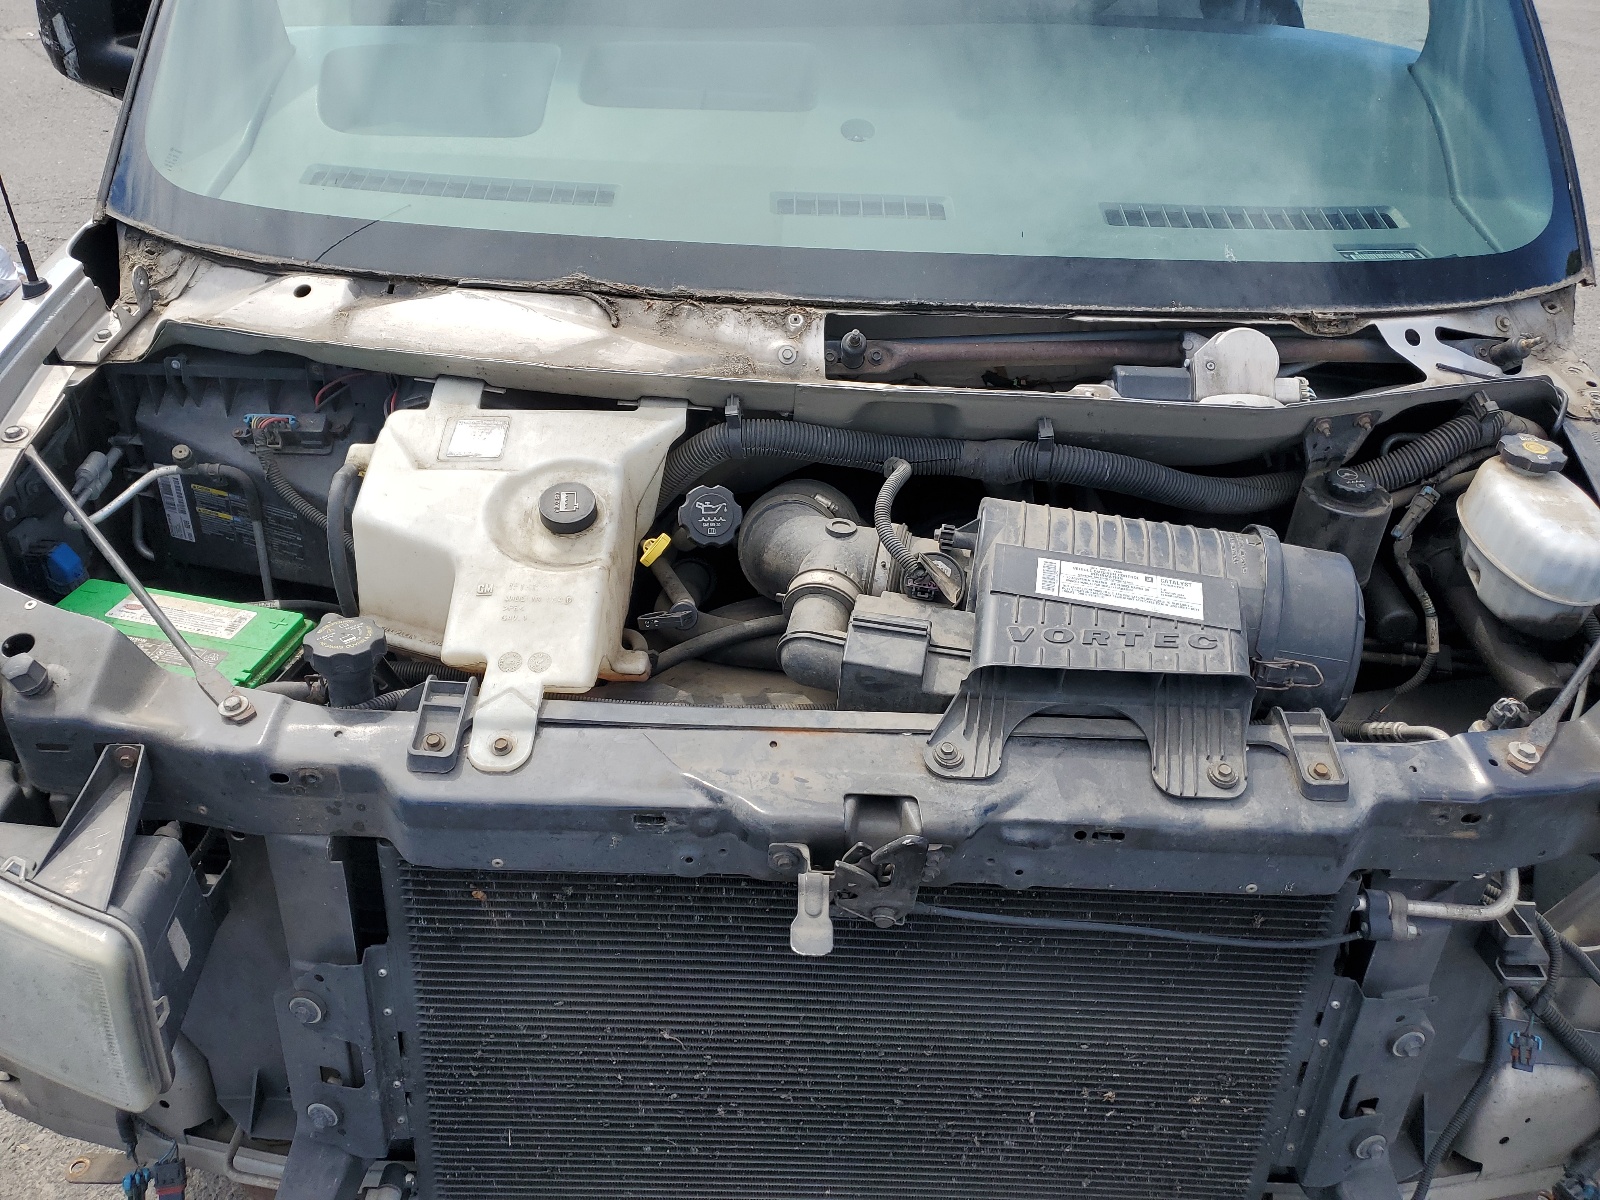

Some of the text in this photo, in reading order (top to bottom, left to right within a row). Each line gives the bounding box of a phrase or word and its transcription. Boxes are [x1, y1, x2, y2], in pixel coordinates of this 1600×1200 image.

[476, 583, 494, 595] GM
[1160, 578, 1192, 588] CATALYST
[1007, 626, 1218, 650] VORTEC
